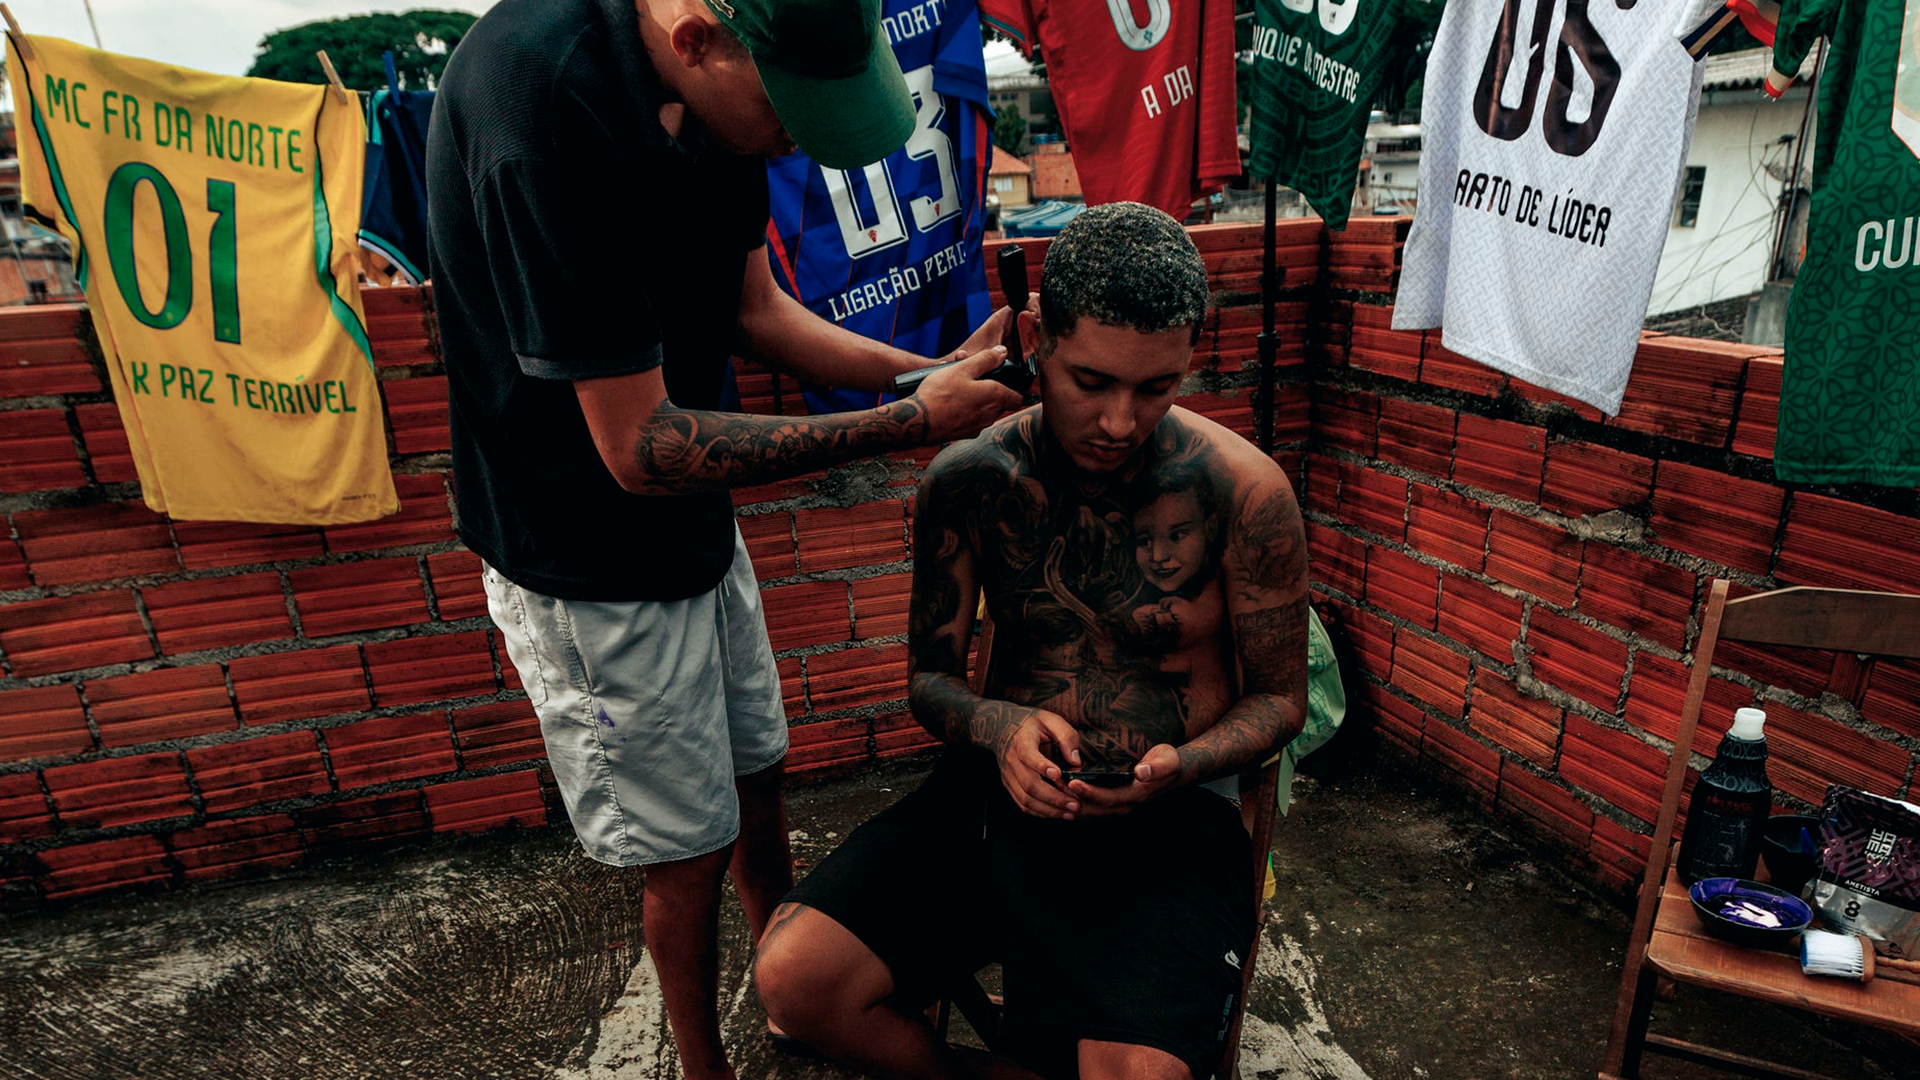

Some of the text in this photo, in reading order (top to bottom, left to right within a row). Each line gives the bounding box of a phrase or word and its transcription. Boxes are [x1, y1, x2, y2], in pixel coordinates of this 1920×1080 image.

[881, 0, 947, 45] NORT
[1141, 65, 1194, 119] A DA
[1312, 52, 1361, 104] MESTRE
[45, 74, 304, 173] MC FR DA NORTE
[1453, 169, 1612, 248] ARTO DE LÍDER
[104, 161, 241, 345] 01
[828, 267, 921, 321] LIGAÇÃO
[131, 361, 357, 415] K PAZ TERRÍVEL
[1844, 879, 1880, 896] AMETISTA
[1844, 900, 1861, 918] 8
